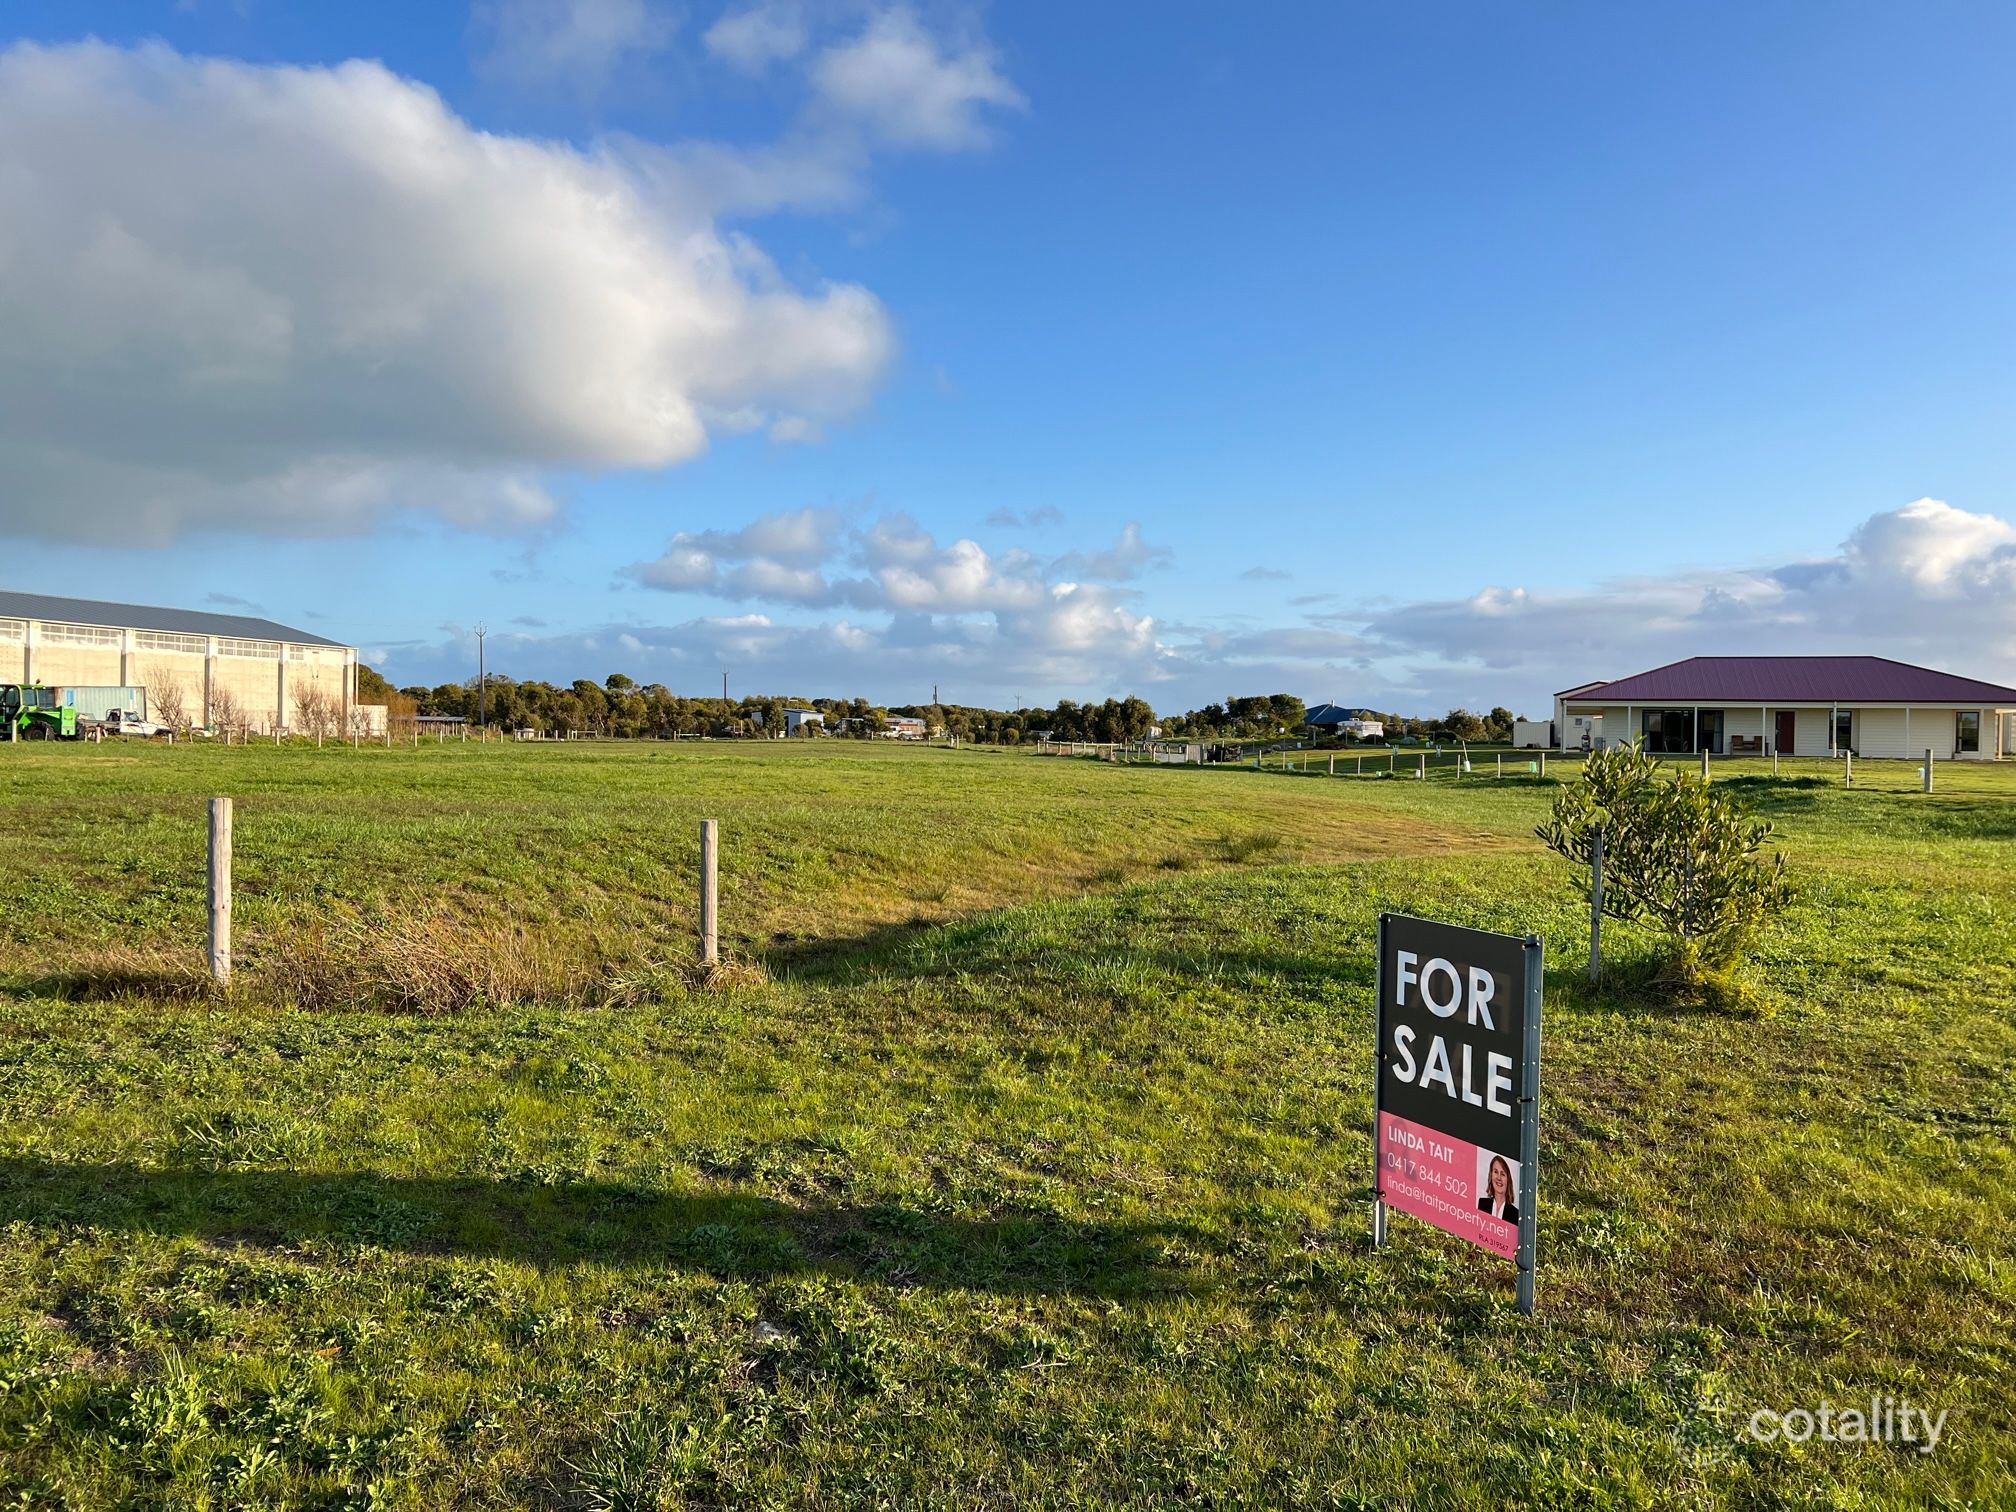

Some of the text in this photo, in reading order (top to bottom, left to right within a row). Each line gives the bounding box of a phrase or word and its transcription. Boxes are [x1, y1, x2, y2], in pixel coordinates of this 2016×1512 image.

[1396, 950, 1495, 1030] FOR
[1392, 1025, 1512, 1117] SALE
[1387, 1152, 1468, 1199] 0417 844 502
[1388, 1125, 1454, 1164] LINDA TAIT
[1387, 1176, 1508, 1239] linda@taitproperty.net
